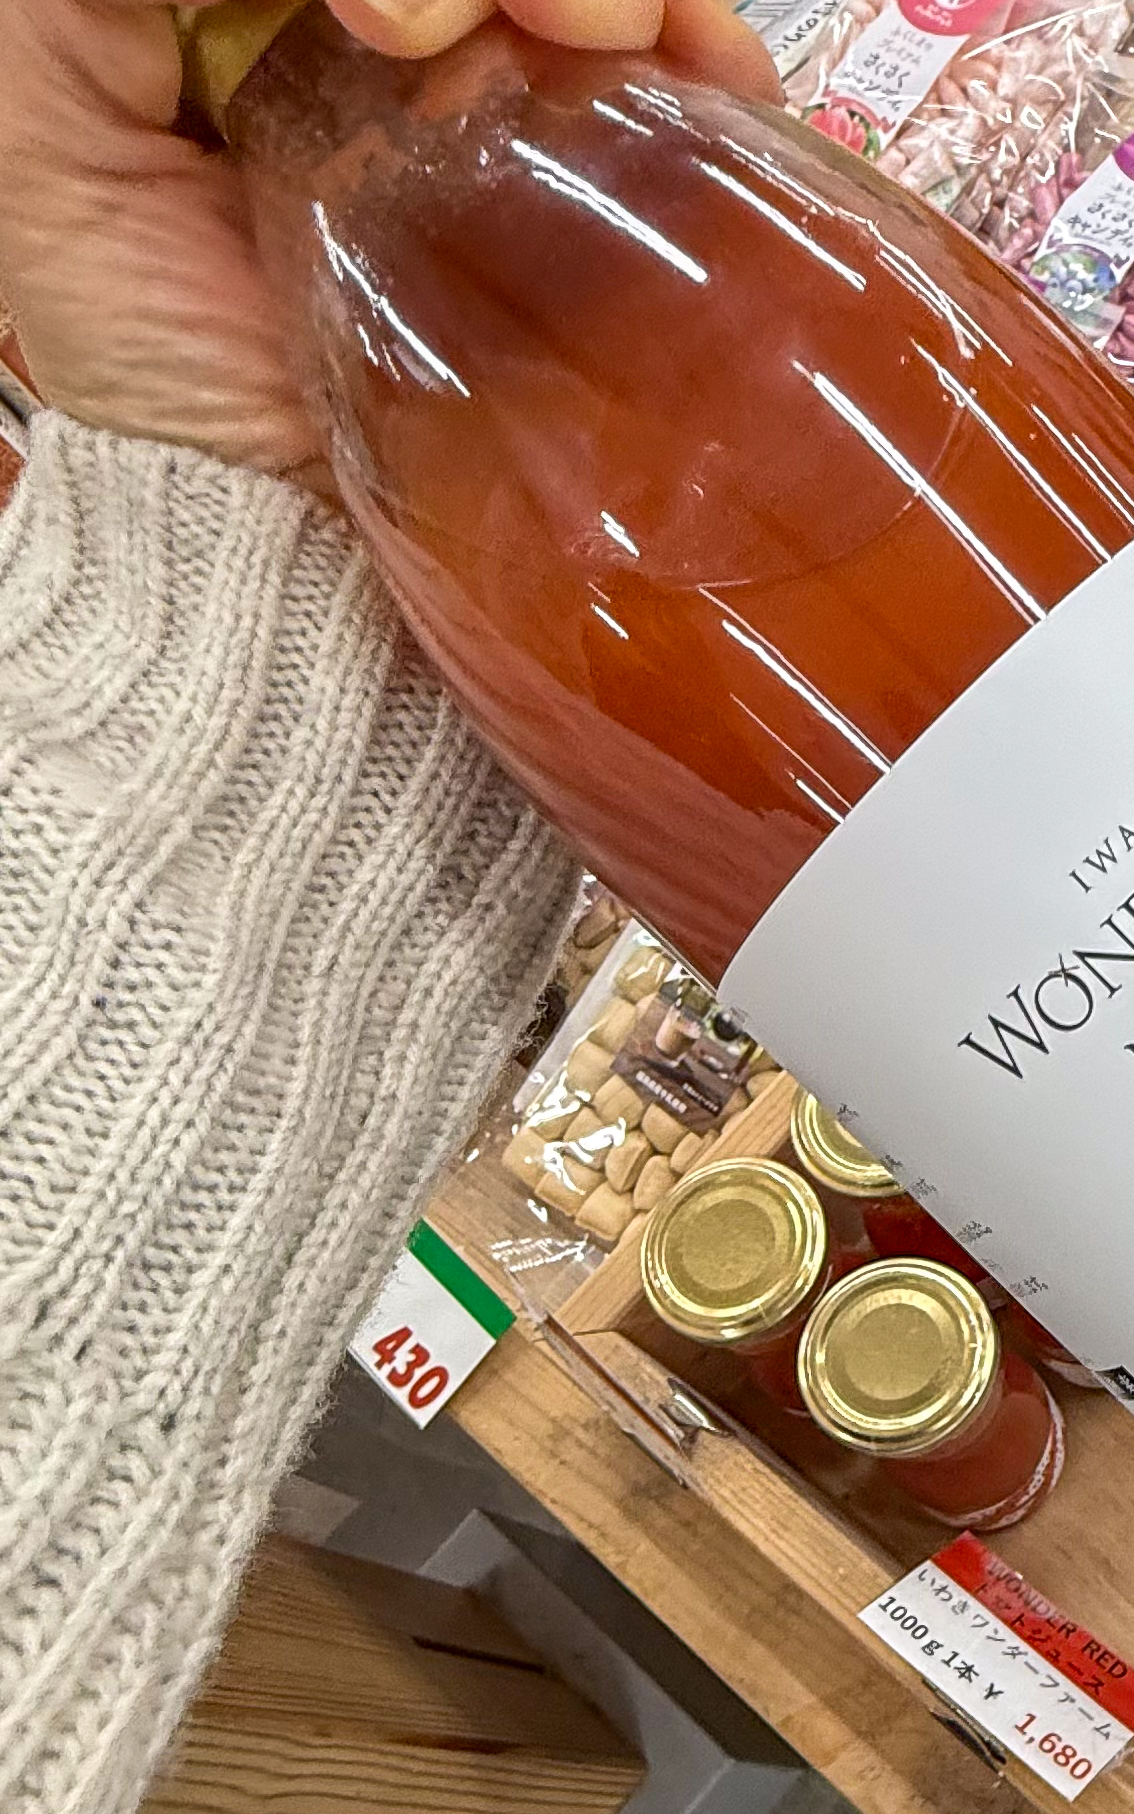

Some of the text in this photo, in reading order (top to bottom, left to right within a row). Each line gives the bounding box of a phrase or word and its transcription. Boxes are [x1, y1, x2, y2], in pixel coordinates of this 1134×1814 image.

[372, 1326, 449, 1409] 430
[918, 1568, 1112, 1741] いわきワンダーファーム
[987, 1561, 1128, 1680] WONDER RED
[1014, 1713, 1093, 1781] 1,680
